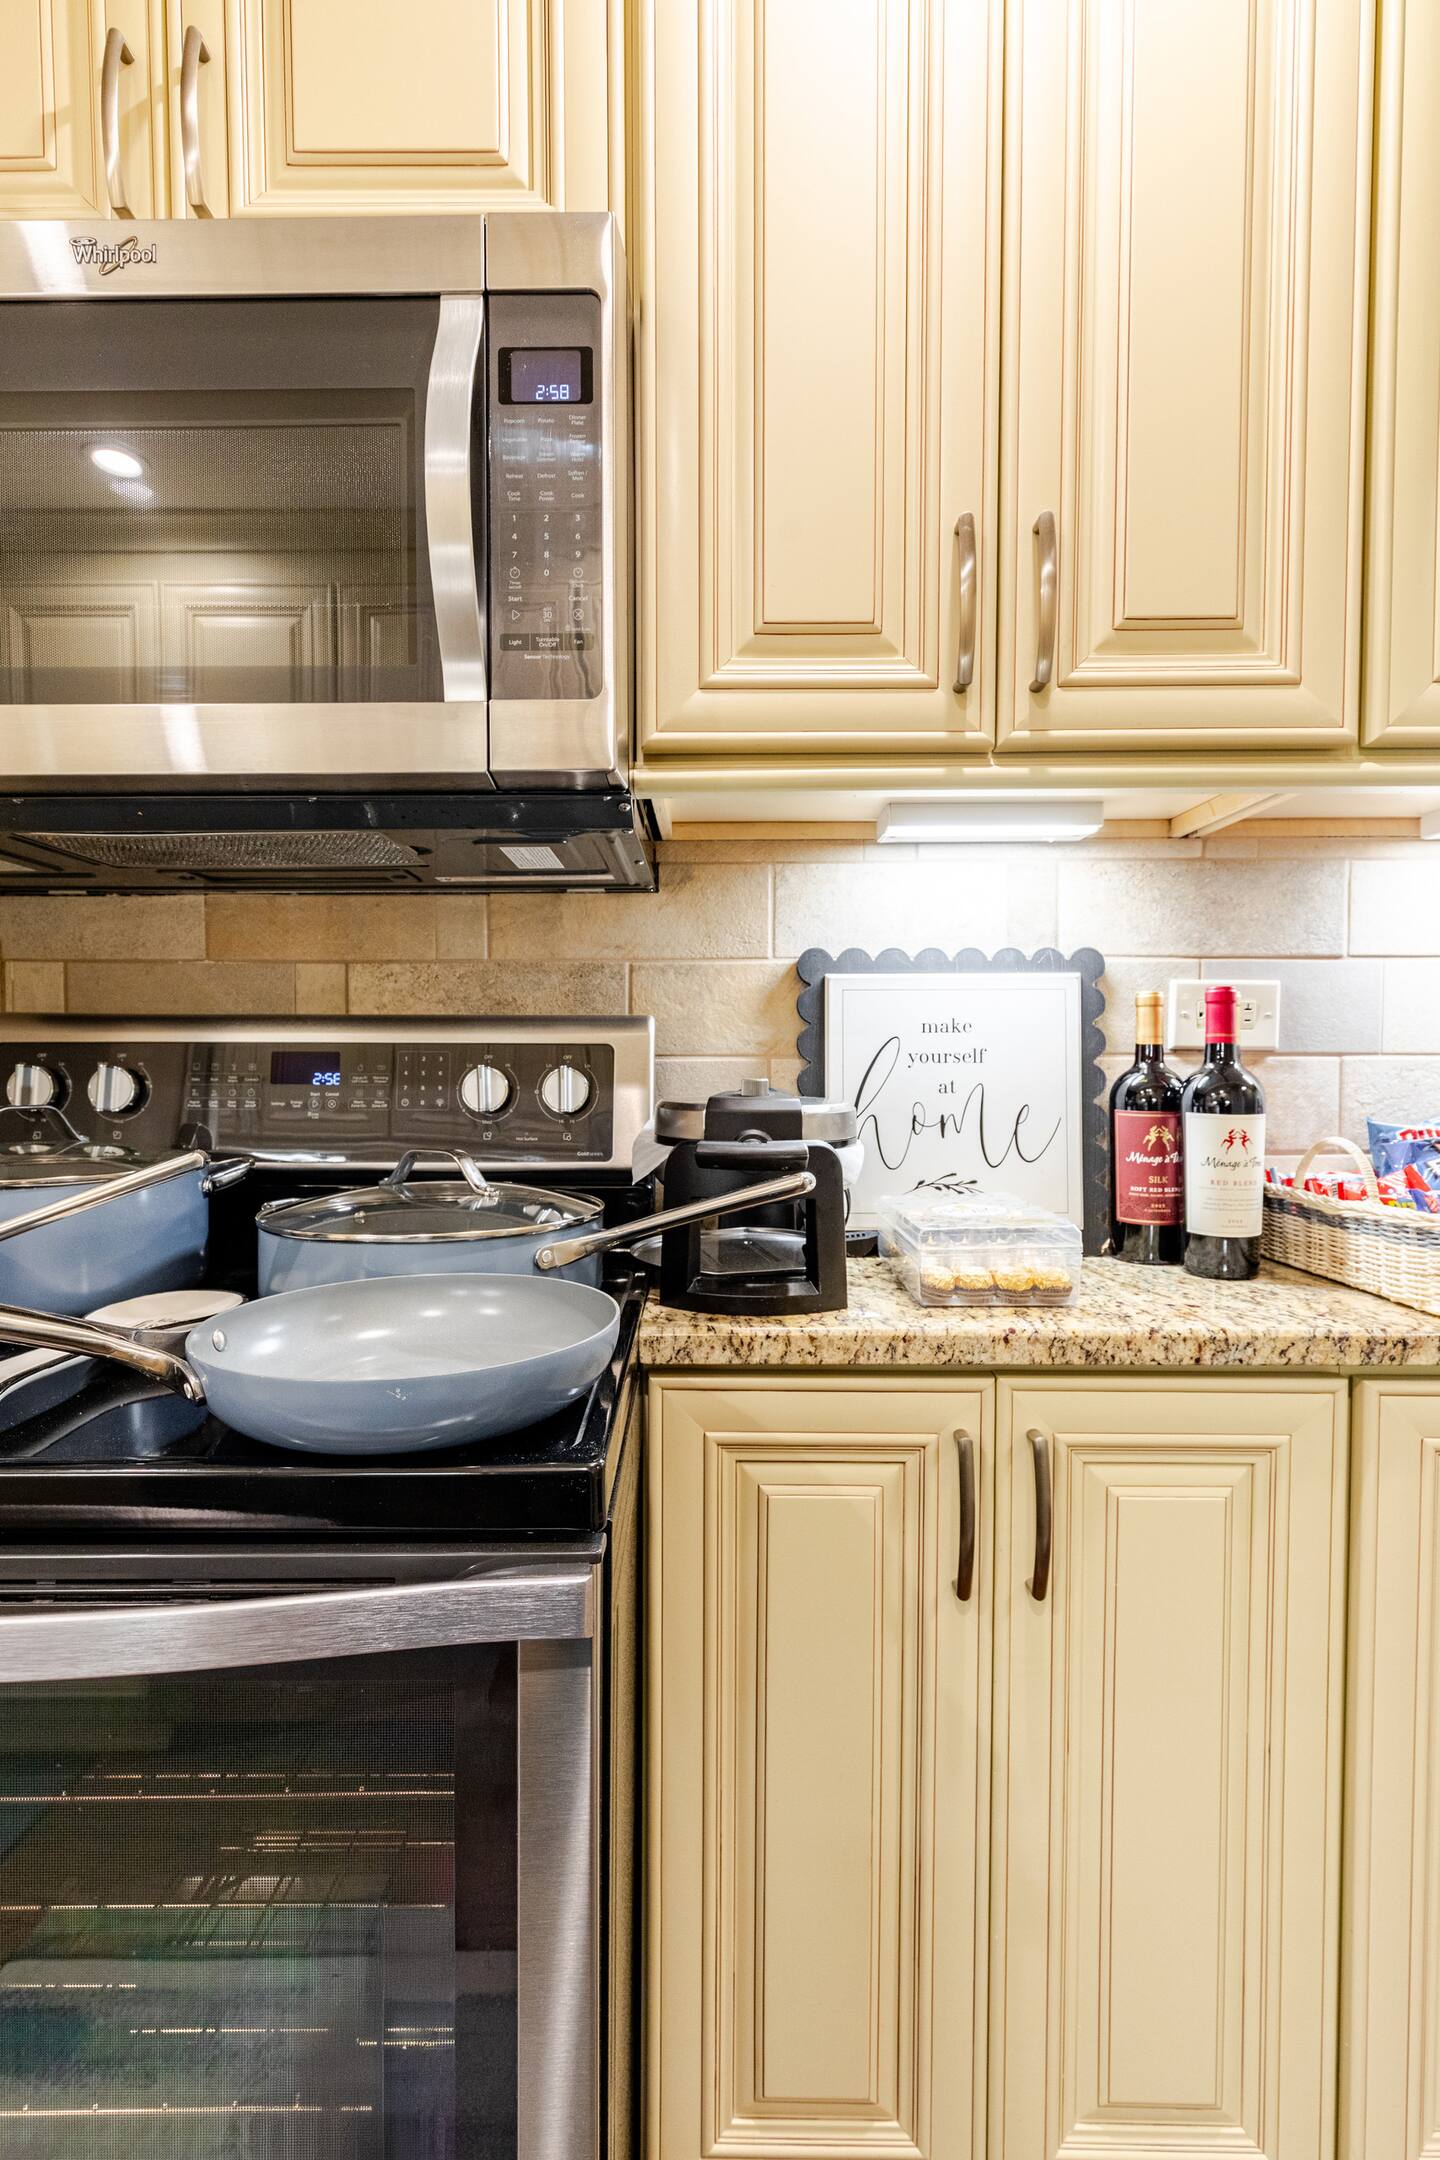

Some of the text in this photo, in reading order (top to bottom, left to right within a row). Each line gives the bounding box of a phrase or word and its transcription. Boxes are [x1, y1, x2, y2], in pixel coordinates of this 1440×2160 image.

[70, 236, 157, 275] Whirlpool
[535, 384, 570, 400] 2:58
[512, 514, 516, 522] 1
[543, 514, 549, 522] 2
[575, 514, 581, 522] 3
[543, 532, 550, 540] 5
[543, 551, 550, 559] 8
[575, 550, 581, 558] 9
[543, 569, 550, 577] 0
[921, 1017, 973, 1034] make
[907, 1047, 988, 1068] yourself
[938, 1080, 957, 1095] at
[855, 1036, 1062, 1171] home
[1148, 1176, 1169, 1184] SILK
